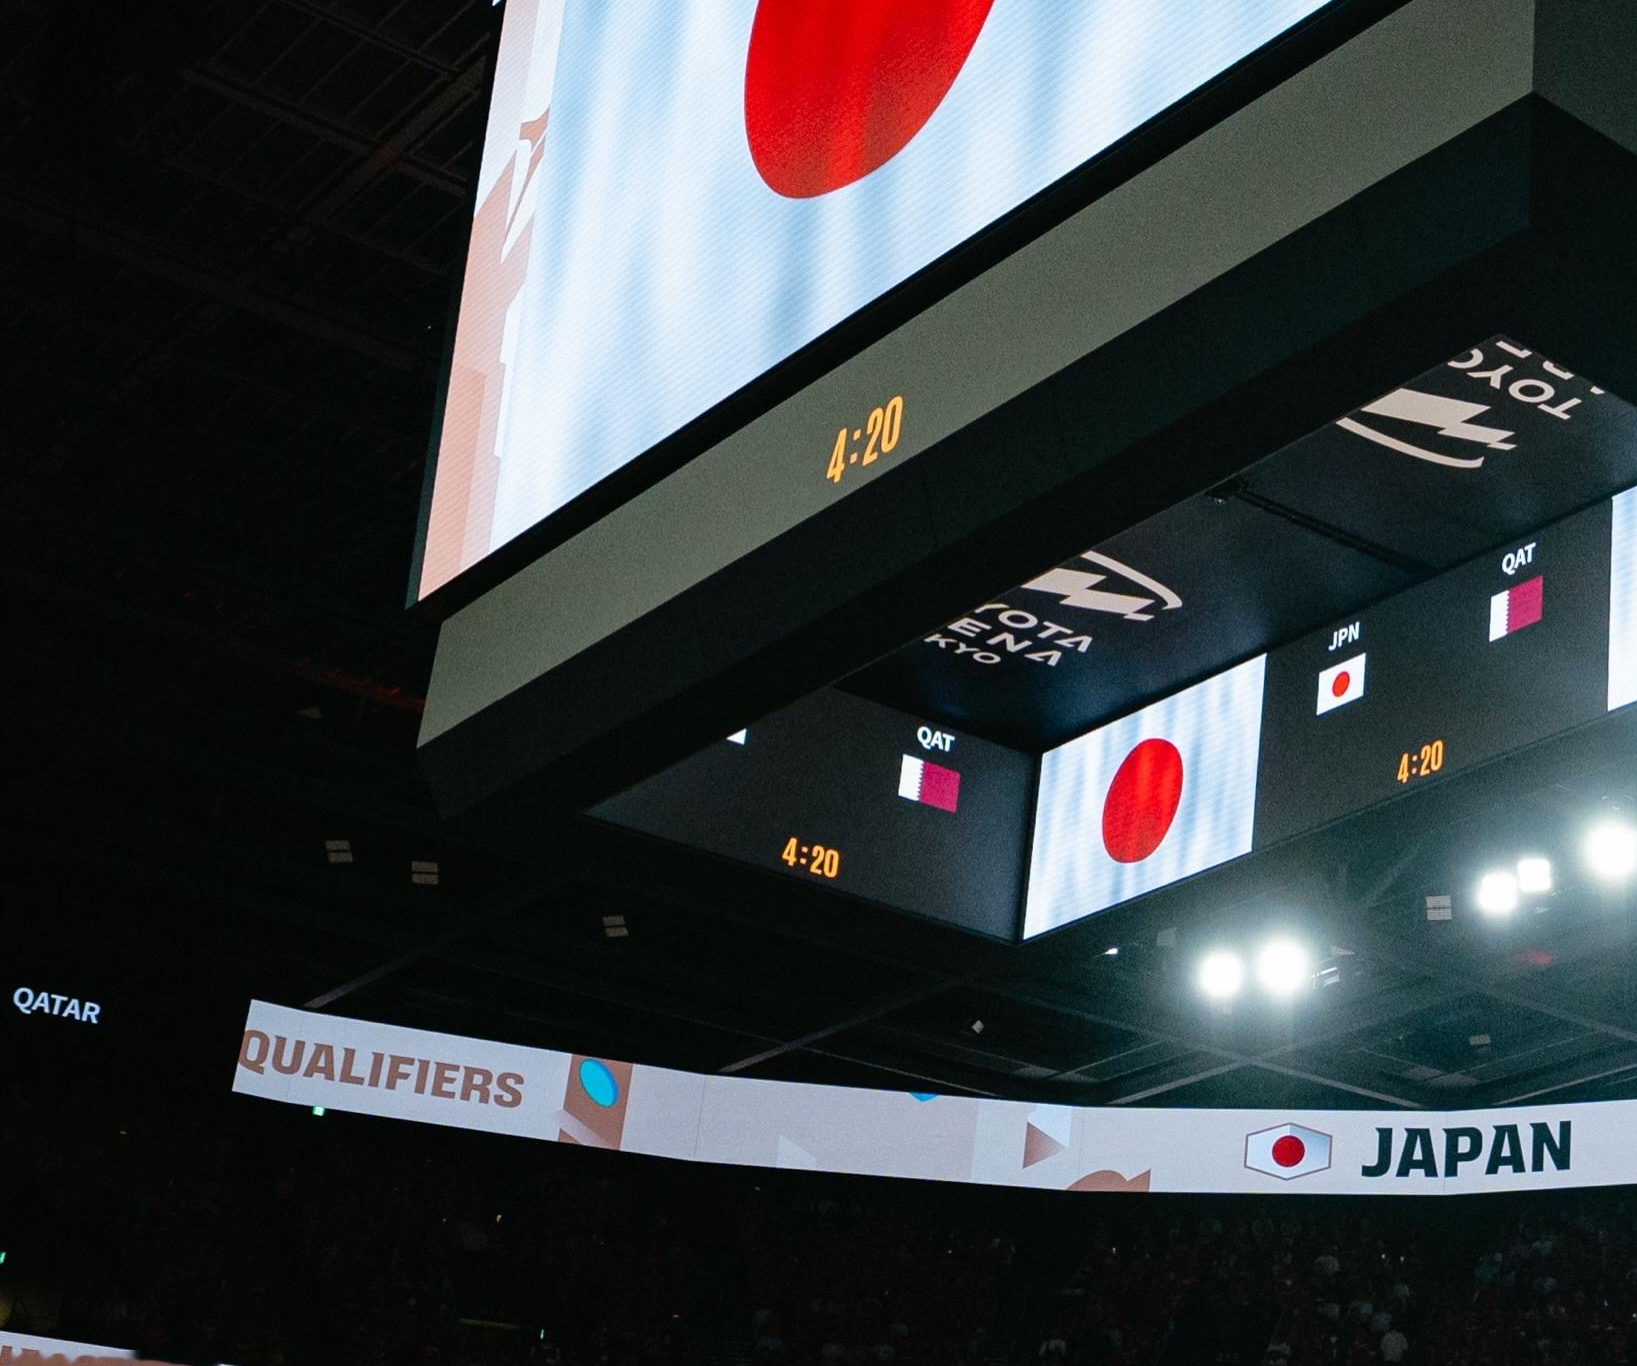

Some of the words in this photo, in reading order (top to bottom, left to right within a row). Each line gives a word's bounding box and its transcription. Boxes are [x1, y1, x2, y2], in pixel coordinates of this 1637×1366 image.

[1447, 348, 1583, 420] TOYO
[826, 395, 904, 483] 4:20
[1502, 542, 1537, 576] QAT
[924, 634, 1001, 665] KYO
[948, 617, 1062, 667] ENA
[973, 603, 1093, 654] YOTA
[1328, 621, 1360, 652] JPN
[916, 726, 956, 752] QAT
[1397, 739, 1444, 784] 4:20
[781, 837, 841, 878] 4:20
[13, 986, 100, 1024] QATAR
[238, 1028, 525, 1109] QUALIFIERS
[1361, 1120, 1573, 1180] JAPAN
